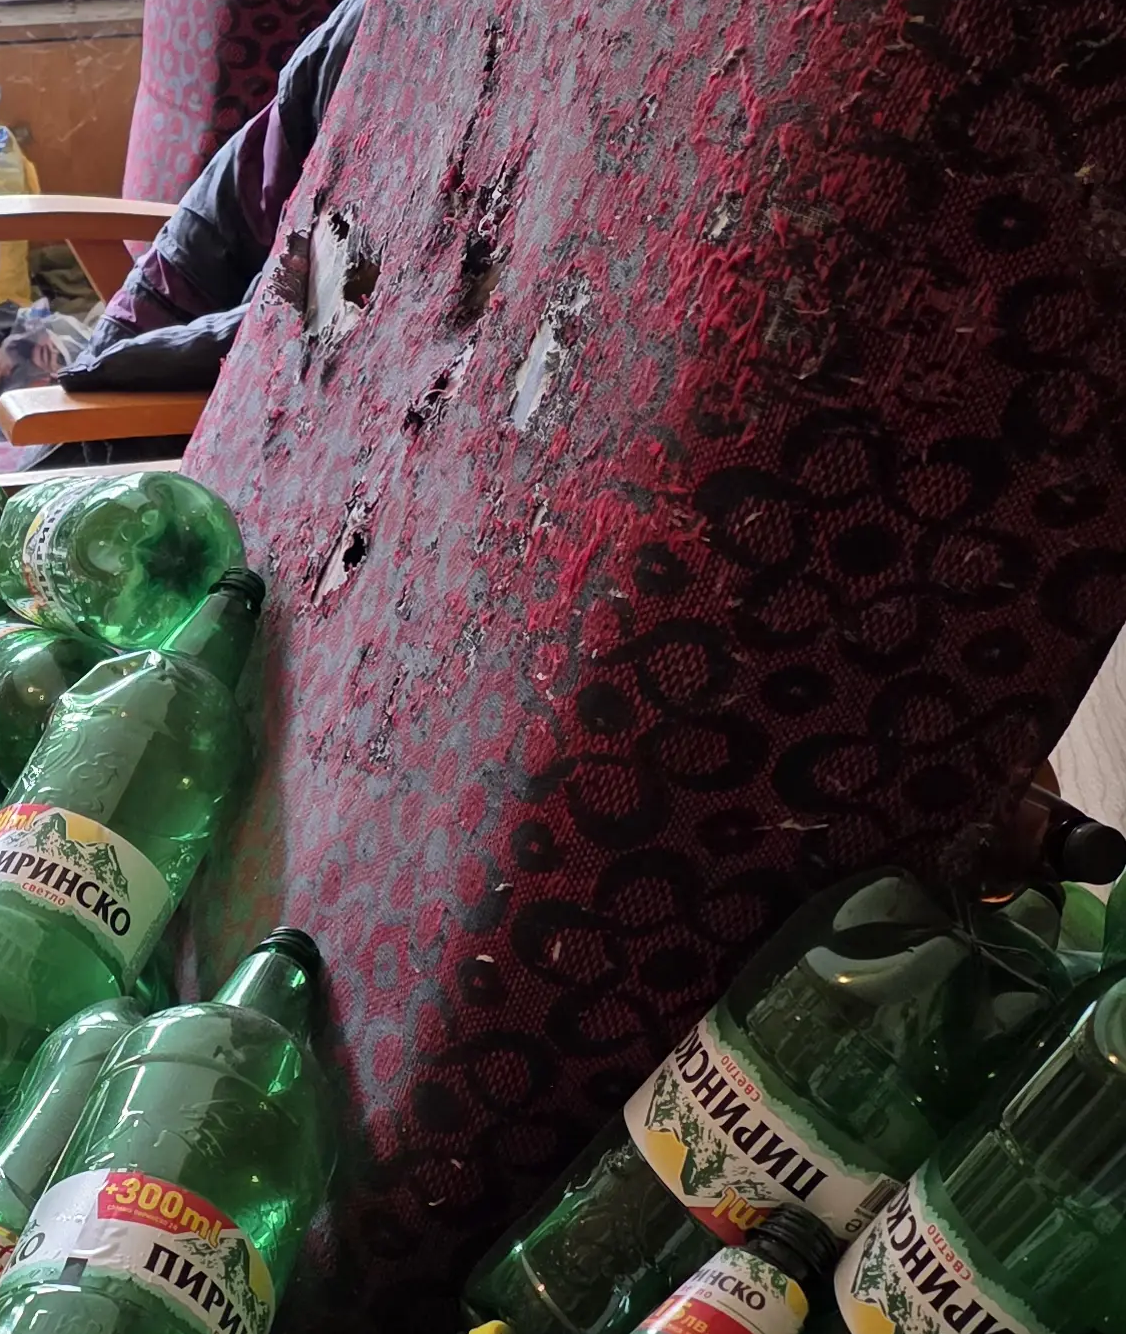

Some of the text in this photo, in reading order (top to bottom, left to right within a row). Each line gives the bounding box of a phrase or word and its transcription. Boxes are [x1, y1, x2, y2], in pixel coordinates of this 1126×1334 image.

[21, 880, 66, 907] светло
[720, 1054, 761, 1102] светло
[106, 1177, 223, 1248] +300ml
[927, 1224, 972, 1281] светло
